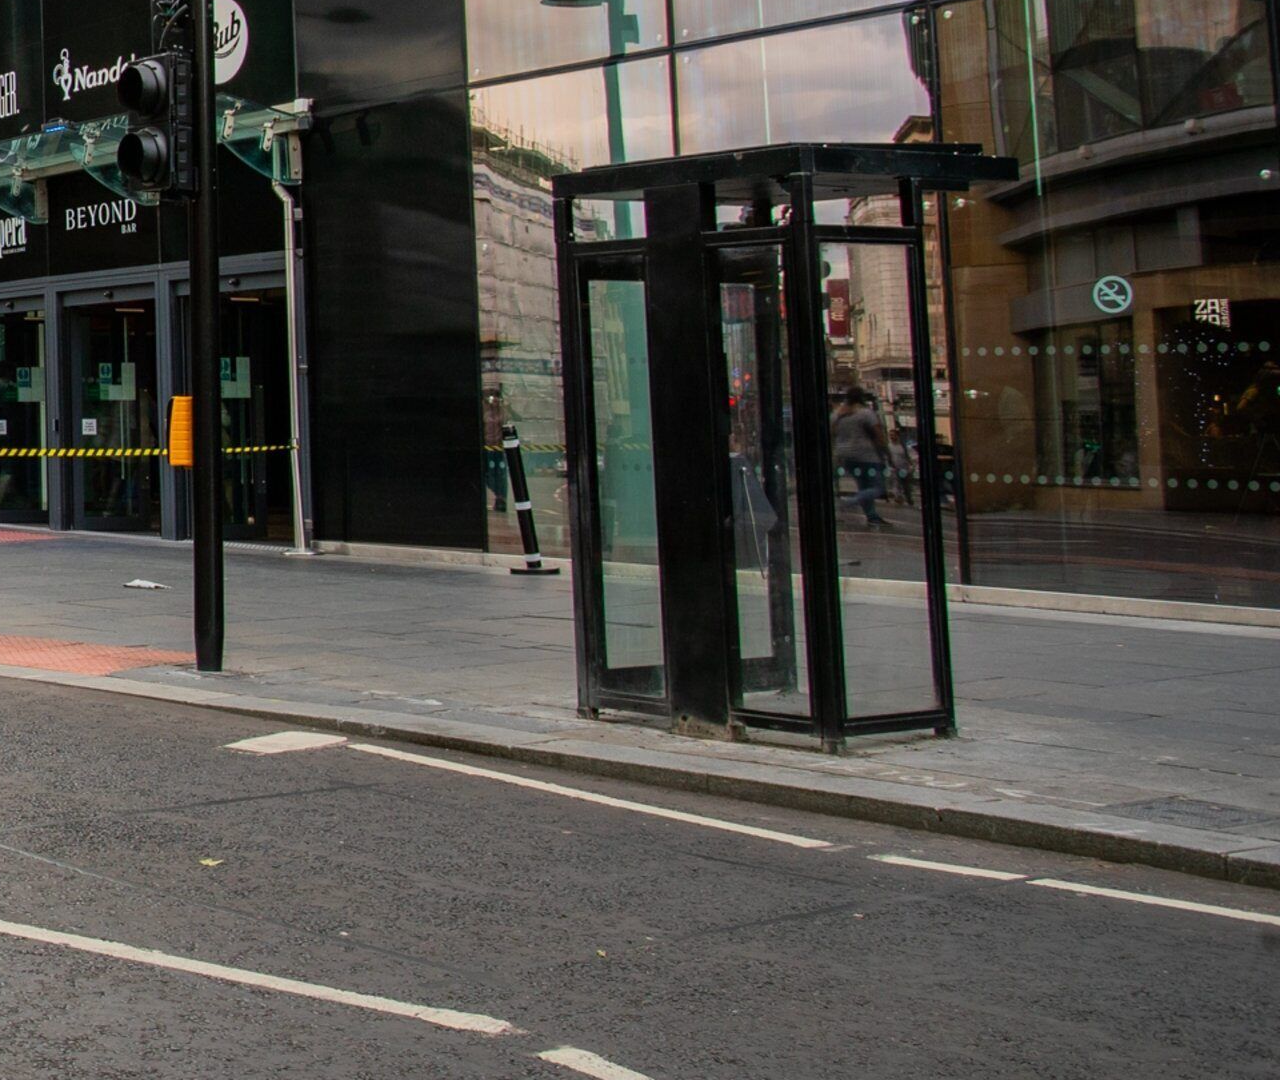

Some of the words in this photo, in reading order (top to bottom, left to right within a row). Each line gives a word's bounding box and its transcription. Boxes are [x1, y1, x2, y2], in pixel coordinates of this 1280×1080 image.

[73, 53, 136, 93] Nand'
[65, 198, 137, 231] BEYOND
[121, 222, 137, 234] BAR
